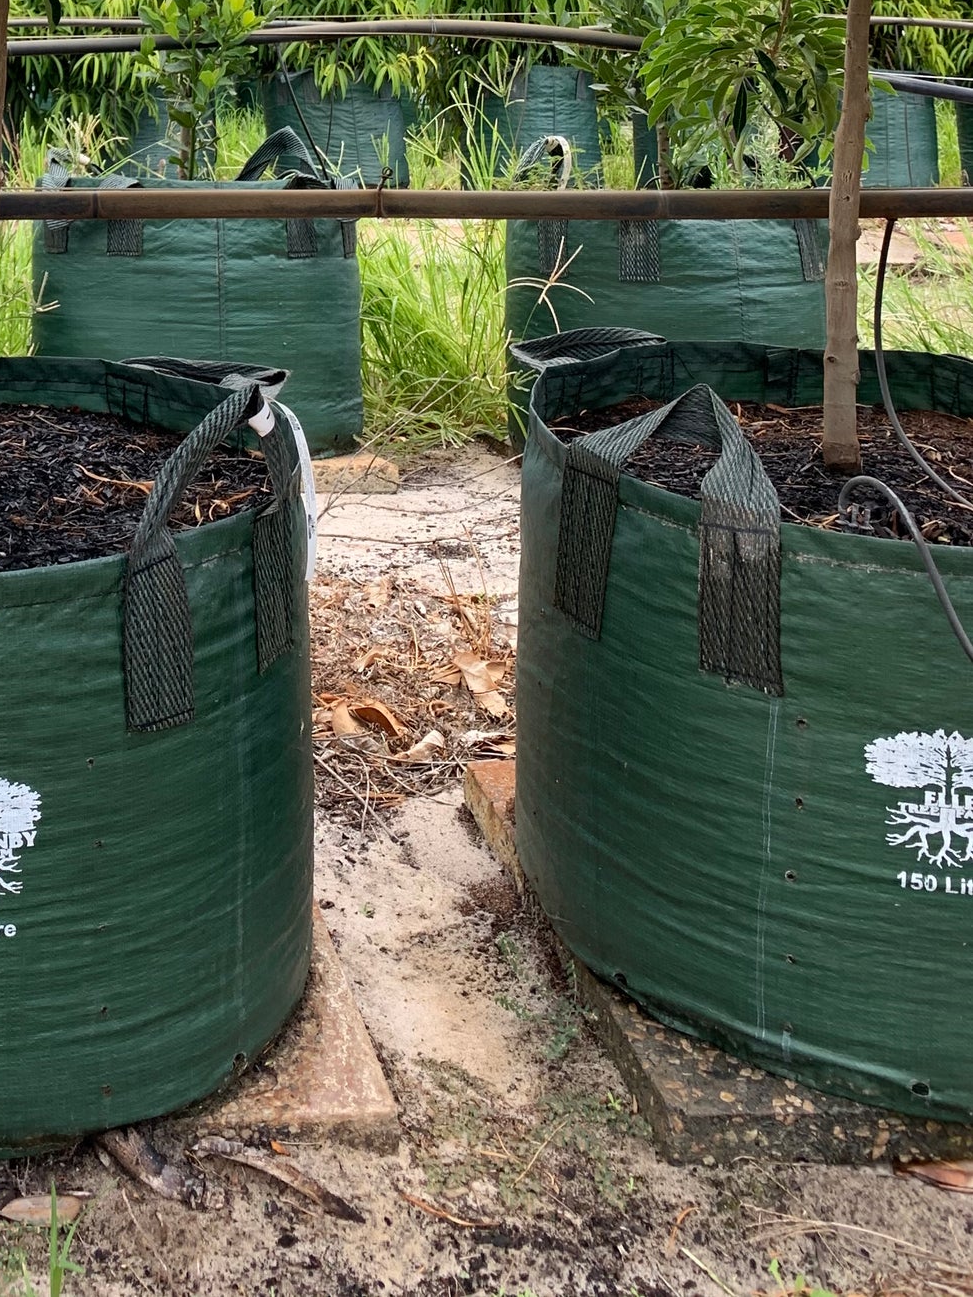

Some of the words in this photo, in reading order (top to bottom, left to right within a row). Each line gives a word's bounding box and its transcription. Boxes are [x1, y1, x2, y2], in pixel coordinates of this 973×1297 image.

[924, 790, 973, 810] ELLE
[897, 801, 940, 817] TREE
[956, 808, 973, 820] FA
[896, 870, 938, 892] 150
[945, 876, 973, 896] Lit
